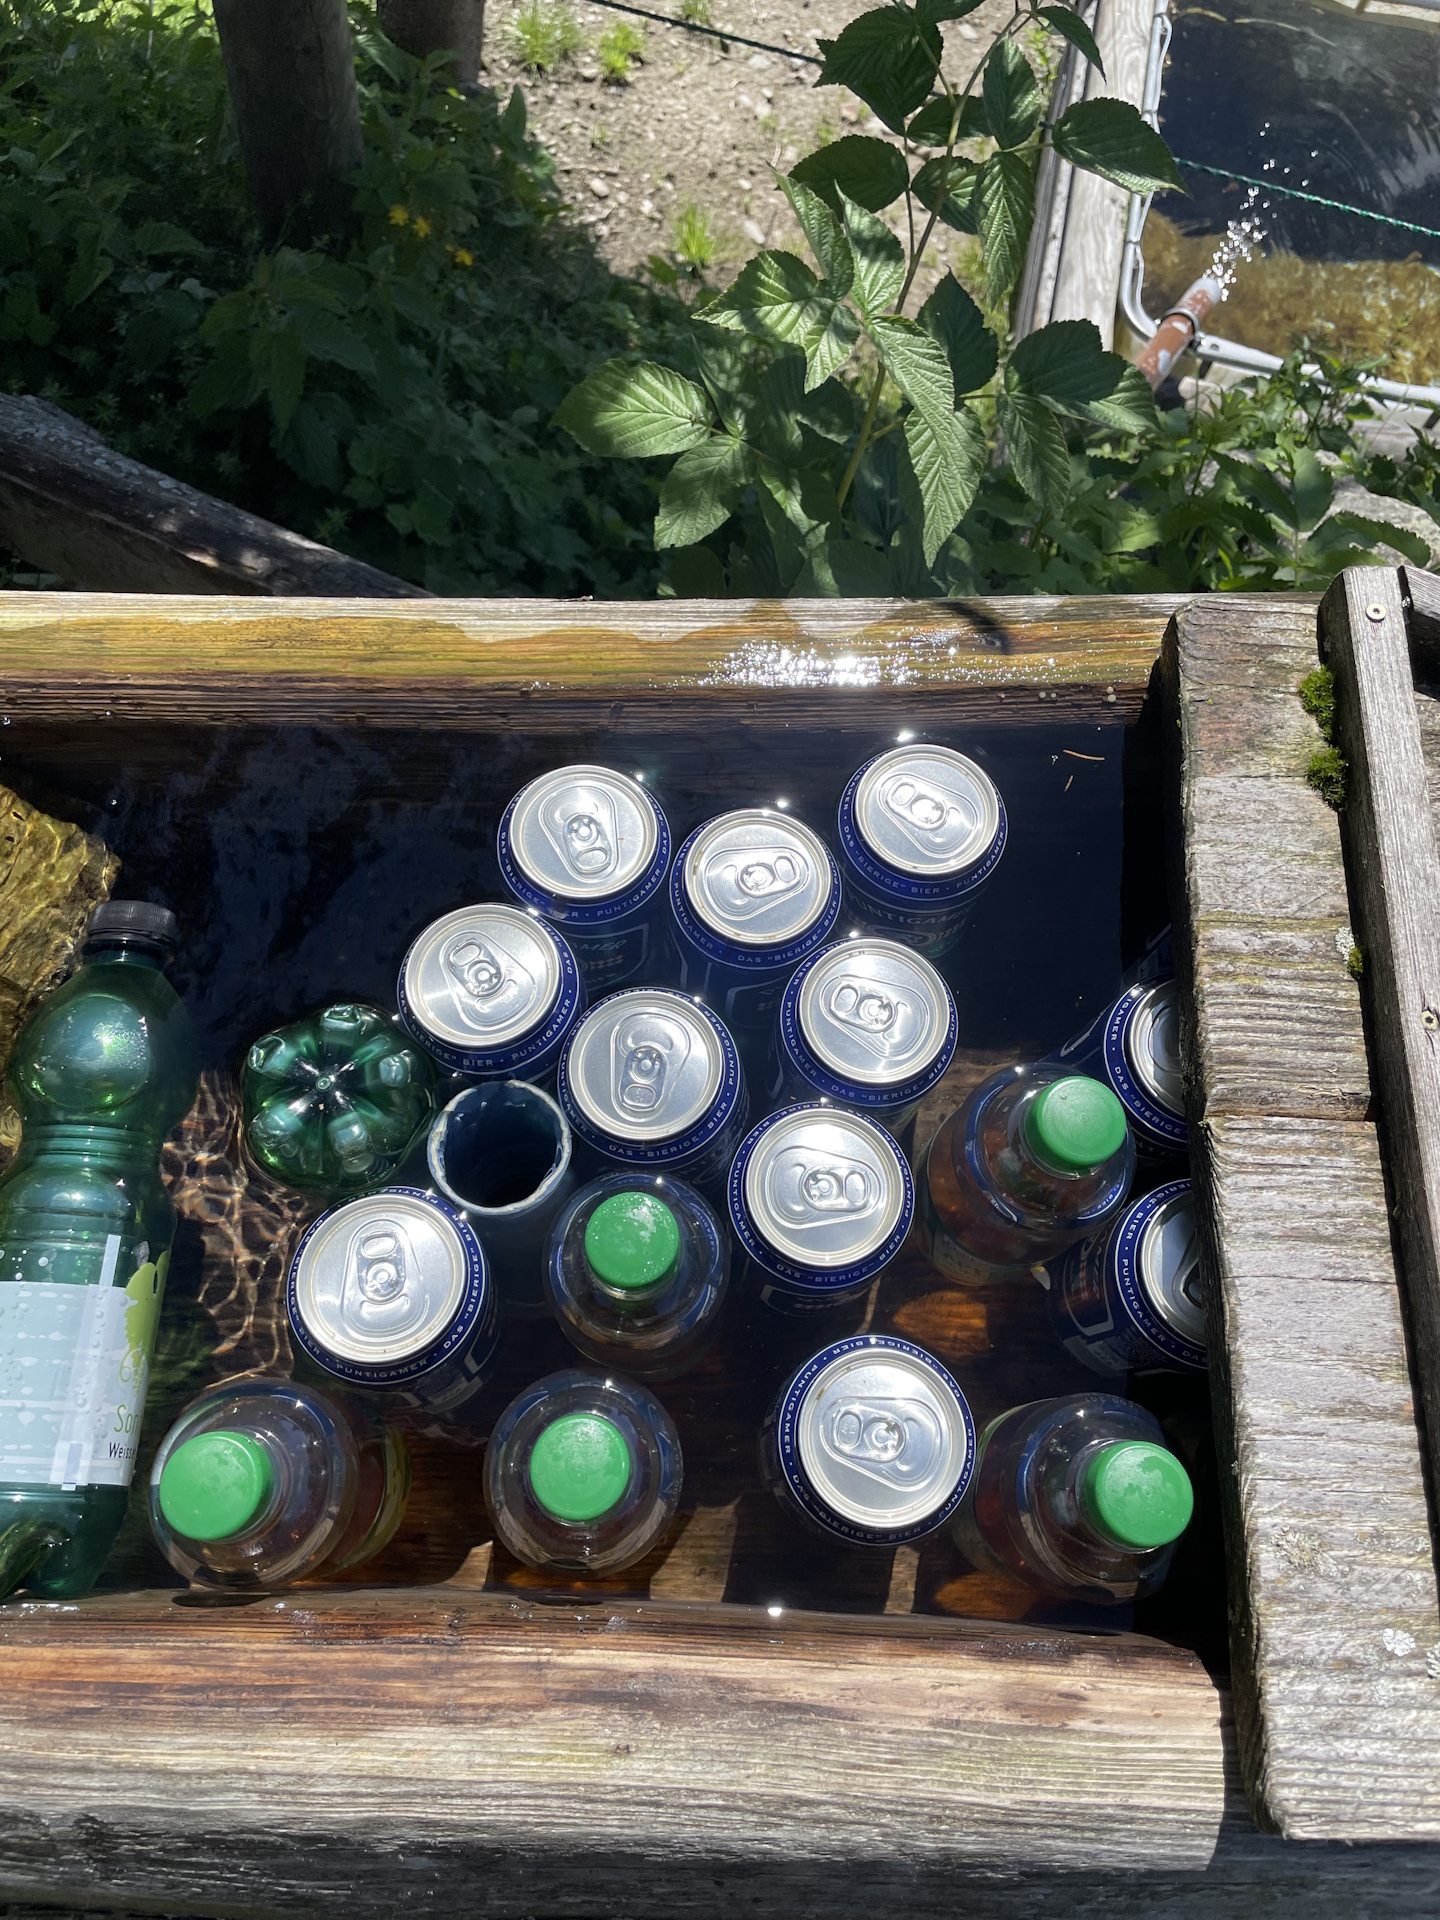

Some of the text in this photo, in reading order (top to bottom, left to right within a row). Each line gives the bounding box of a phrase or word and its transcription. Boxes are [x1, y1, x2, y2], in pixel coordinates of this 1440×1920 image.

[676, 840, 692, 867] BIER
[844, 825, 855, 849] DAS
[910, 886, 941, 895] BIER
[956, 831, 1004, 889] PUNTIGAMER
[596, 868, 661, 917] PUNTIGAMER
[674, 882, 714, 950] PUNTIGAMER
[823, 899, 837, 927] BIER
[737, 954, 762, 964] DAS
[792, 960, 813, 986] BIER
[462, 1058, 495, 1068] BIER
[511, 998, 572, 1061] PUNTIGAMER
[562, 951, 574, 975] DAS
[703, 1009, 736, 1086] PUNTIGAMER
[784, 1000, 818, 1078] PUNTIGAMER
[927, 1053, 948, 1080] BIER
[1114, 1065, 1130, 1091] DAS
[830, 1084, 856, 1099] DAS
[607, 1144, 634, 1156] DAS
[706, 1100, 728, 1131] BIER
[746, 1120, 770, 1144] BIER
[732, 1160, 756, 1247] PUNTIGAMER
[304, 1218, 324, 1243] DAS
[451, 1213, 472, 1242] BIER
[1126, 1211, 1145, 1240] BIER
[879, 1233, 901, 1261] BIER
[775, 1263, 801, 1279] DAS
[1121, 1258, 1167, 1343] PUNTIGAMER
[298, 1327, 321, 1356] BIER
[443, 1325, 465, 1350] DAS
[335, 1358, 428, 1379] PUNTIGAMER
[783, 1363, 818, 1454] PUNTIGAMER
[832, 1339, 865, 1355] BIER
[942, 1372, 961, 1399] DAS
[937, 1428, 973, 1519] PUNTIGAMER
[792, 1473, 812, 1501] DAS
[888, 1526, 922, 1541] BIER
